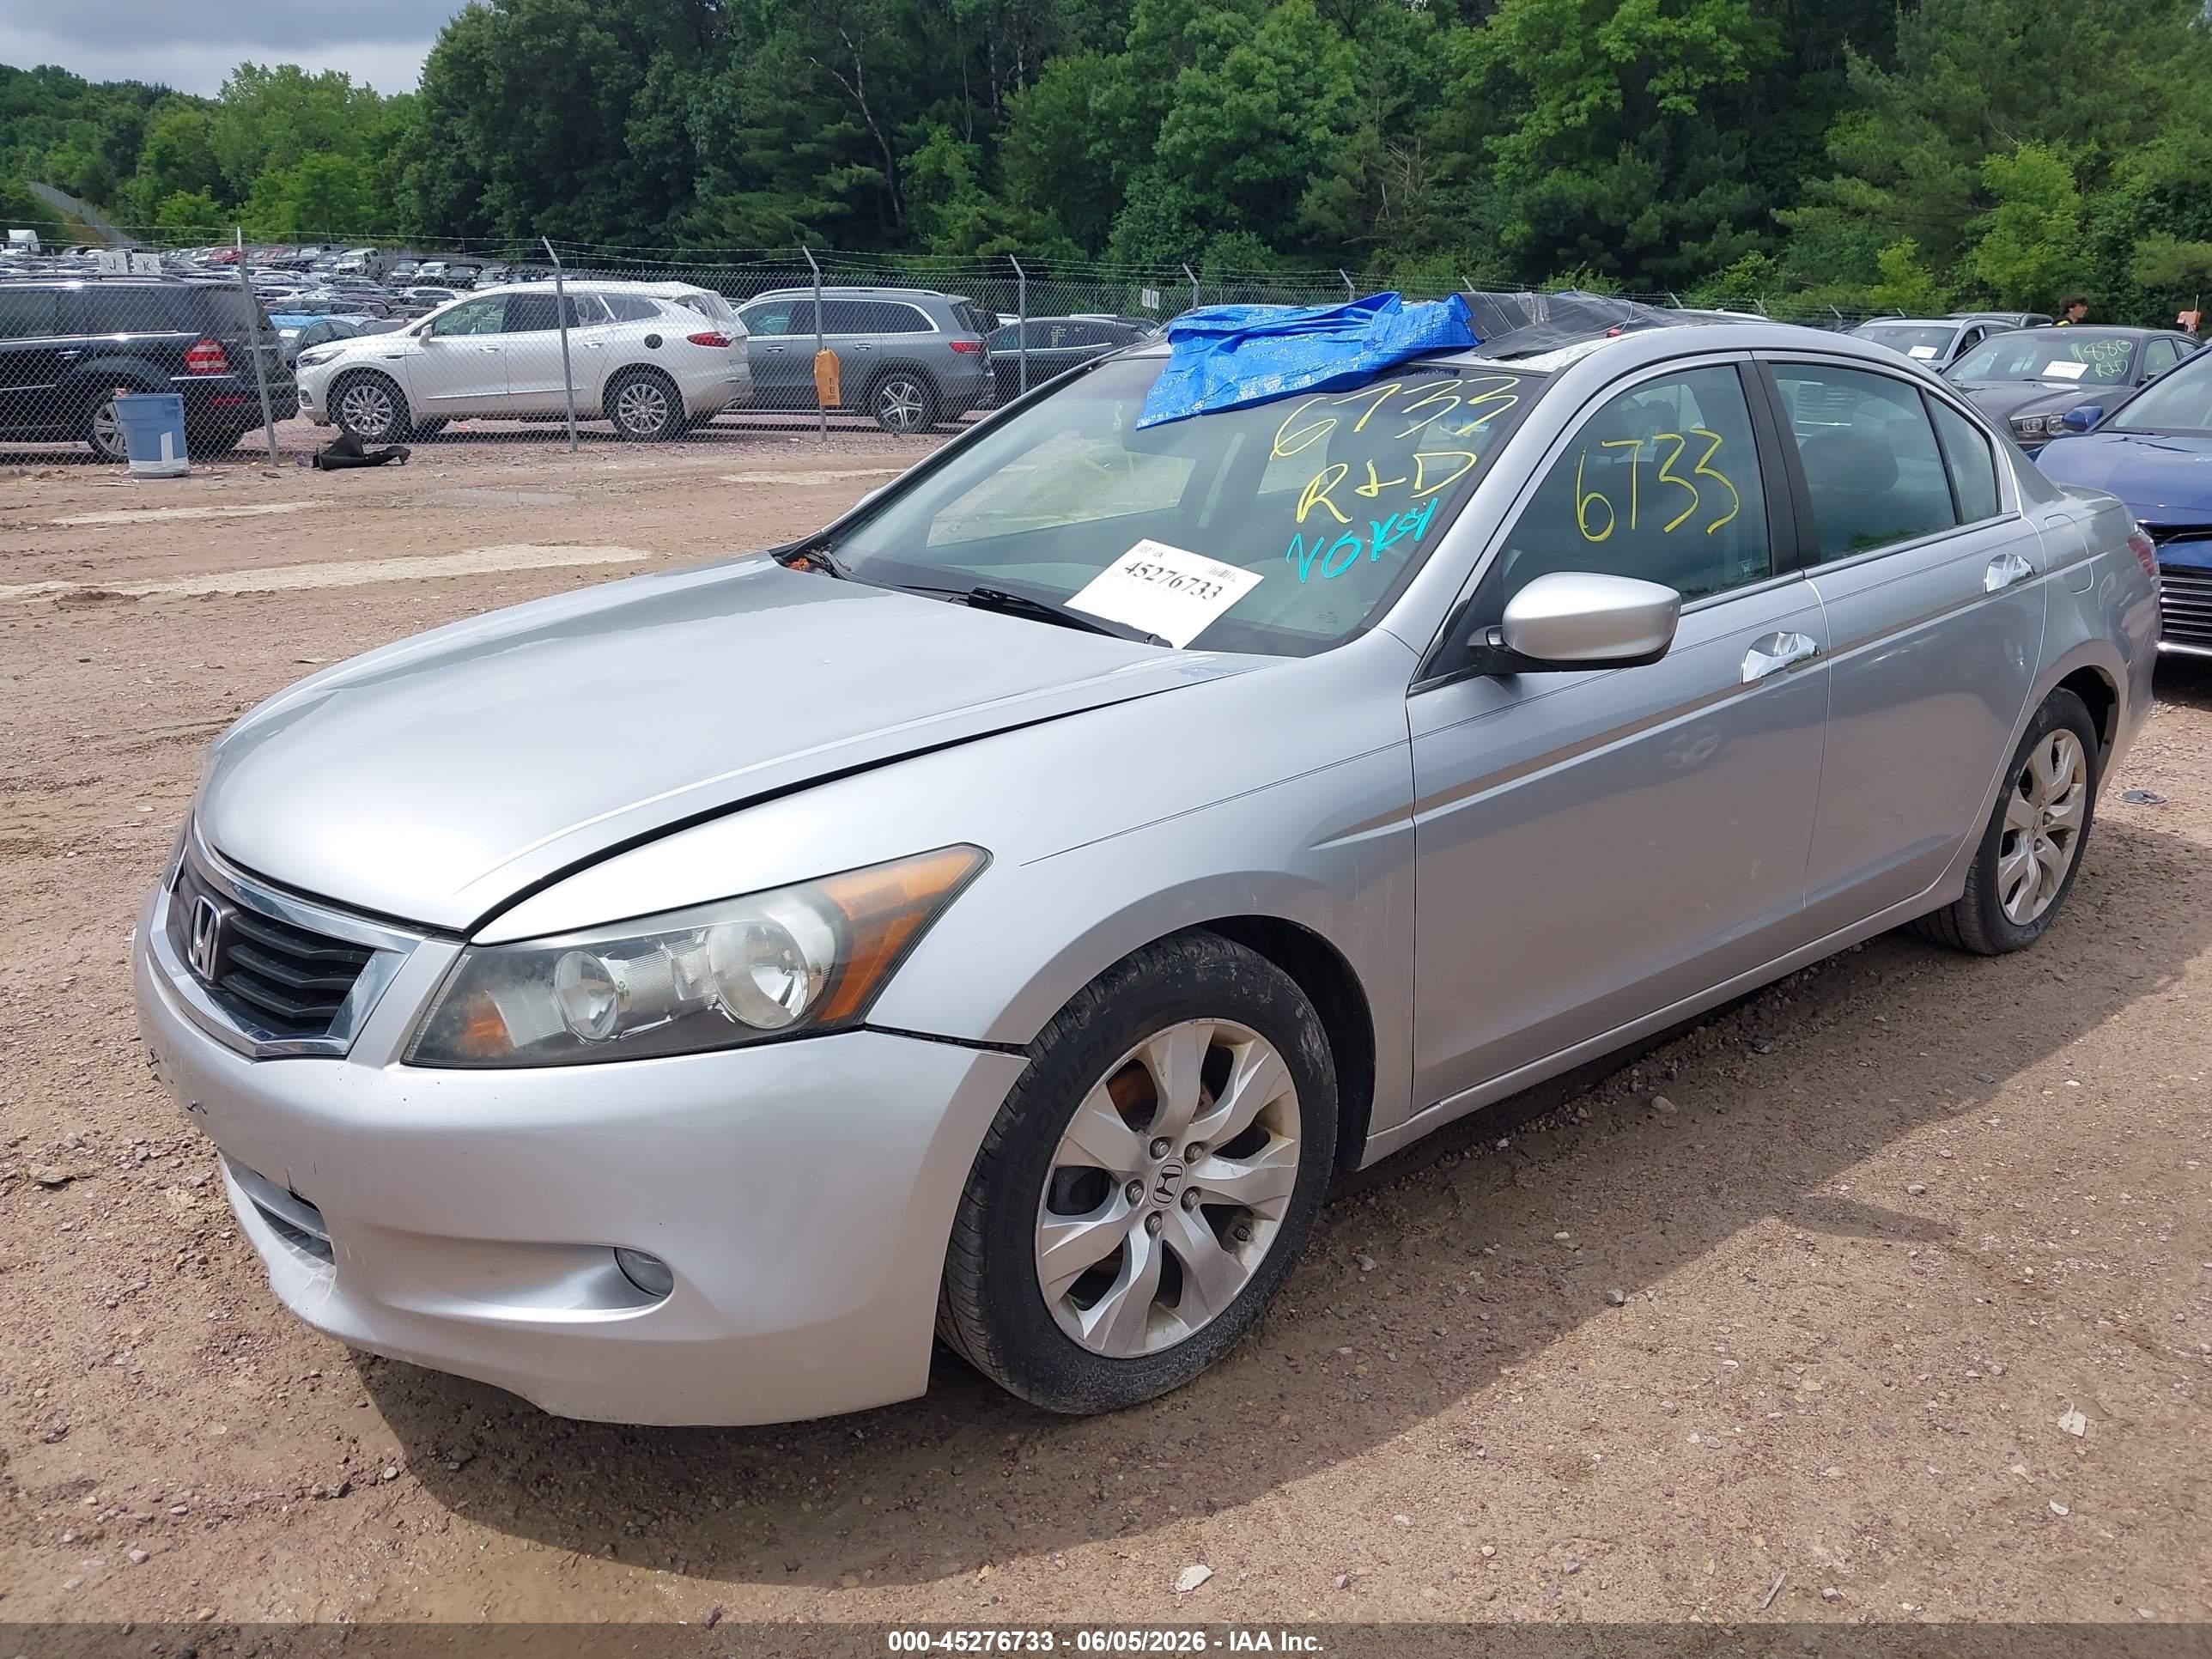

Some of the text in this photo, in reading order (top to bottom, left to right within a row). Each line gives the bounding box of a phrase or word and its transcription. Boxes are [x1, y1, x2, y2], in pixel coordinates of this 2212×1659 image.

[1269, 376, 1521, 461] 6733
[1575, 427, 1741, 543] 6733
[1123, 561, 1224, 600] 45276733
